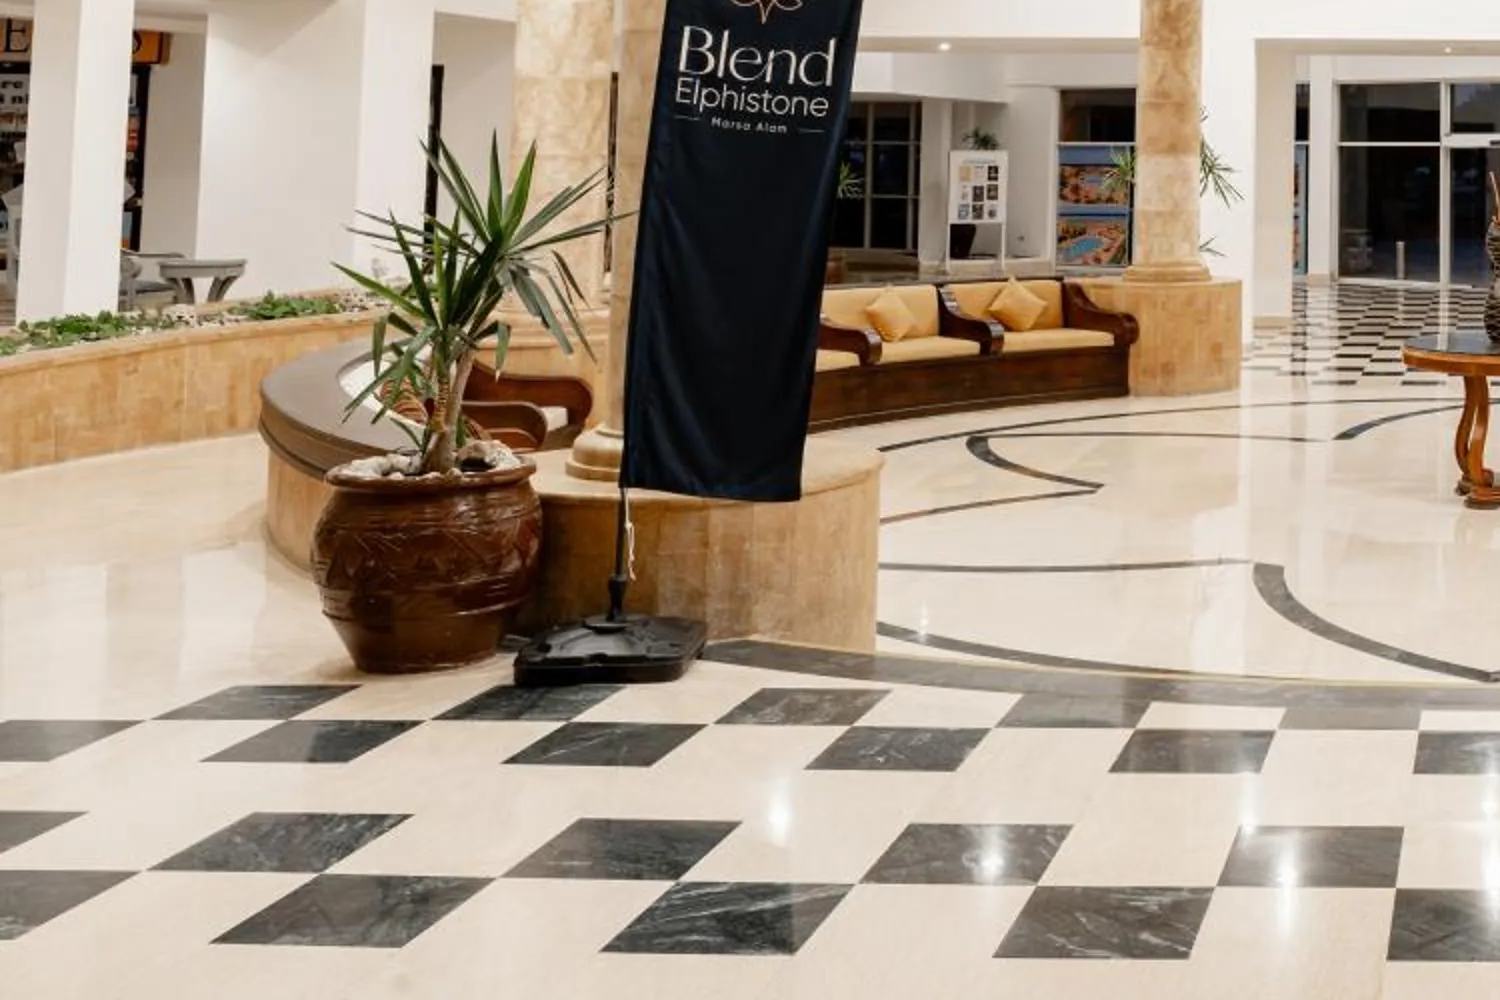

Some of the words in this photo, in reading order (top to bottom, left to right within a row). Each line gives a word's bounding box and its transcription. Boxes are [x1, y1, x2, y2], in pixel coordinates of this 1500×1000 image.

[679, 25, 837, 87] Blend
[675, 77, 830, 118] Elphistone
[710, 116, 751, 131] Marsa
[755, 121, 788, 134] Alam
